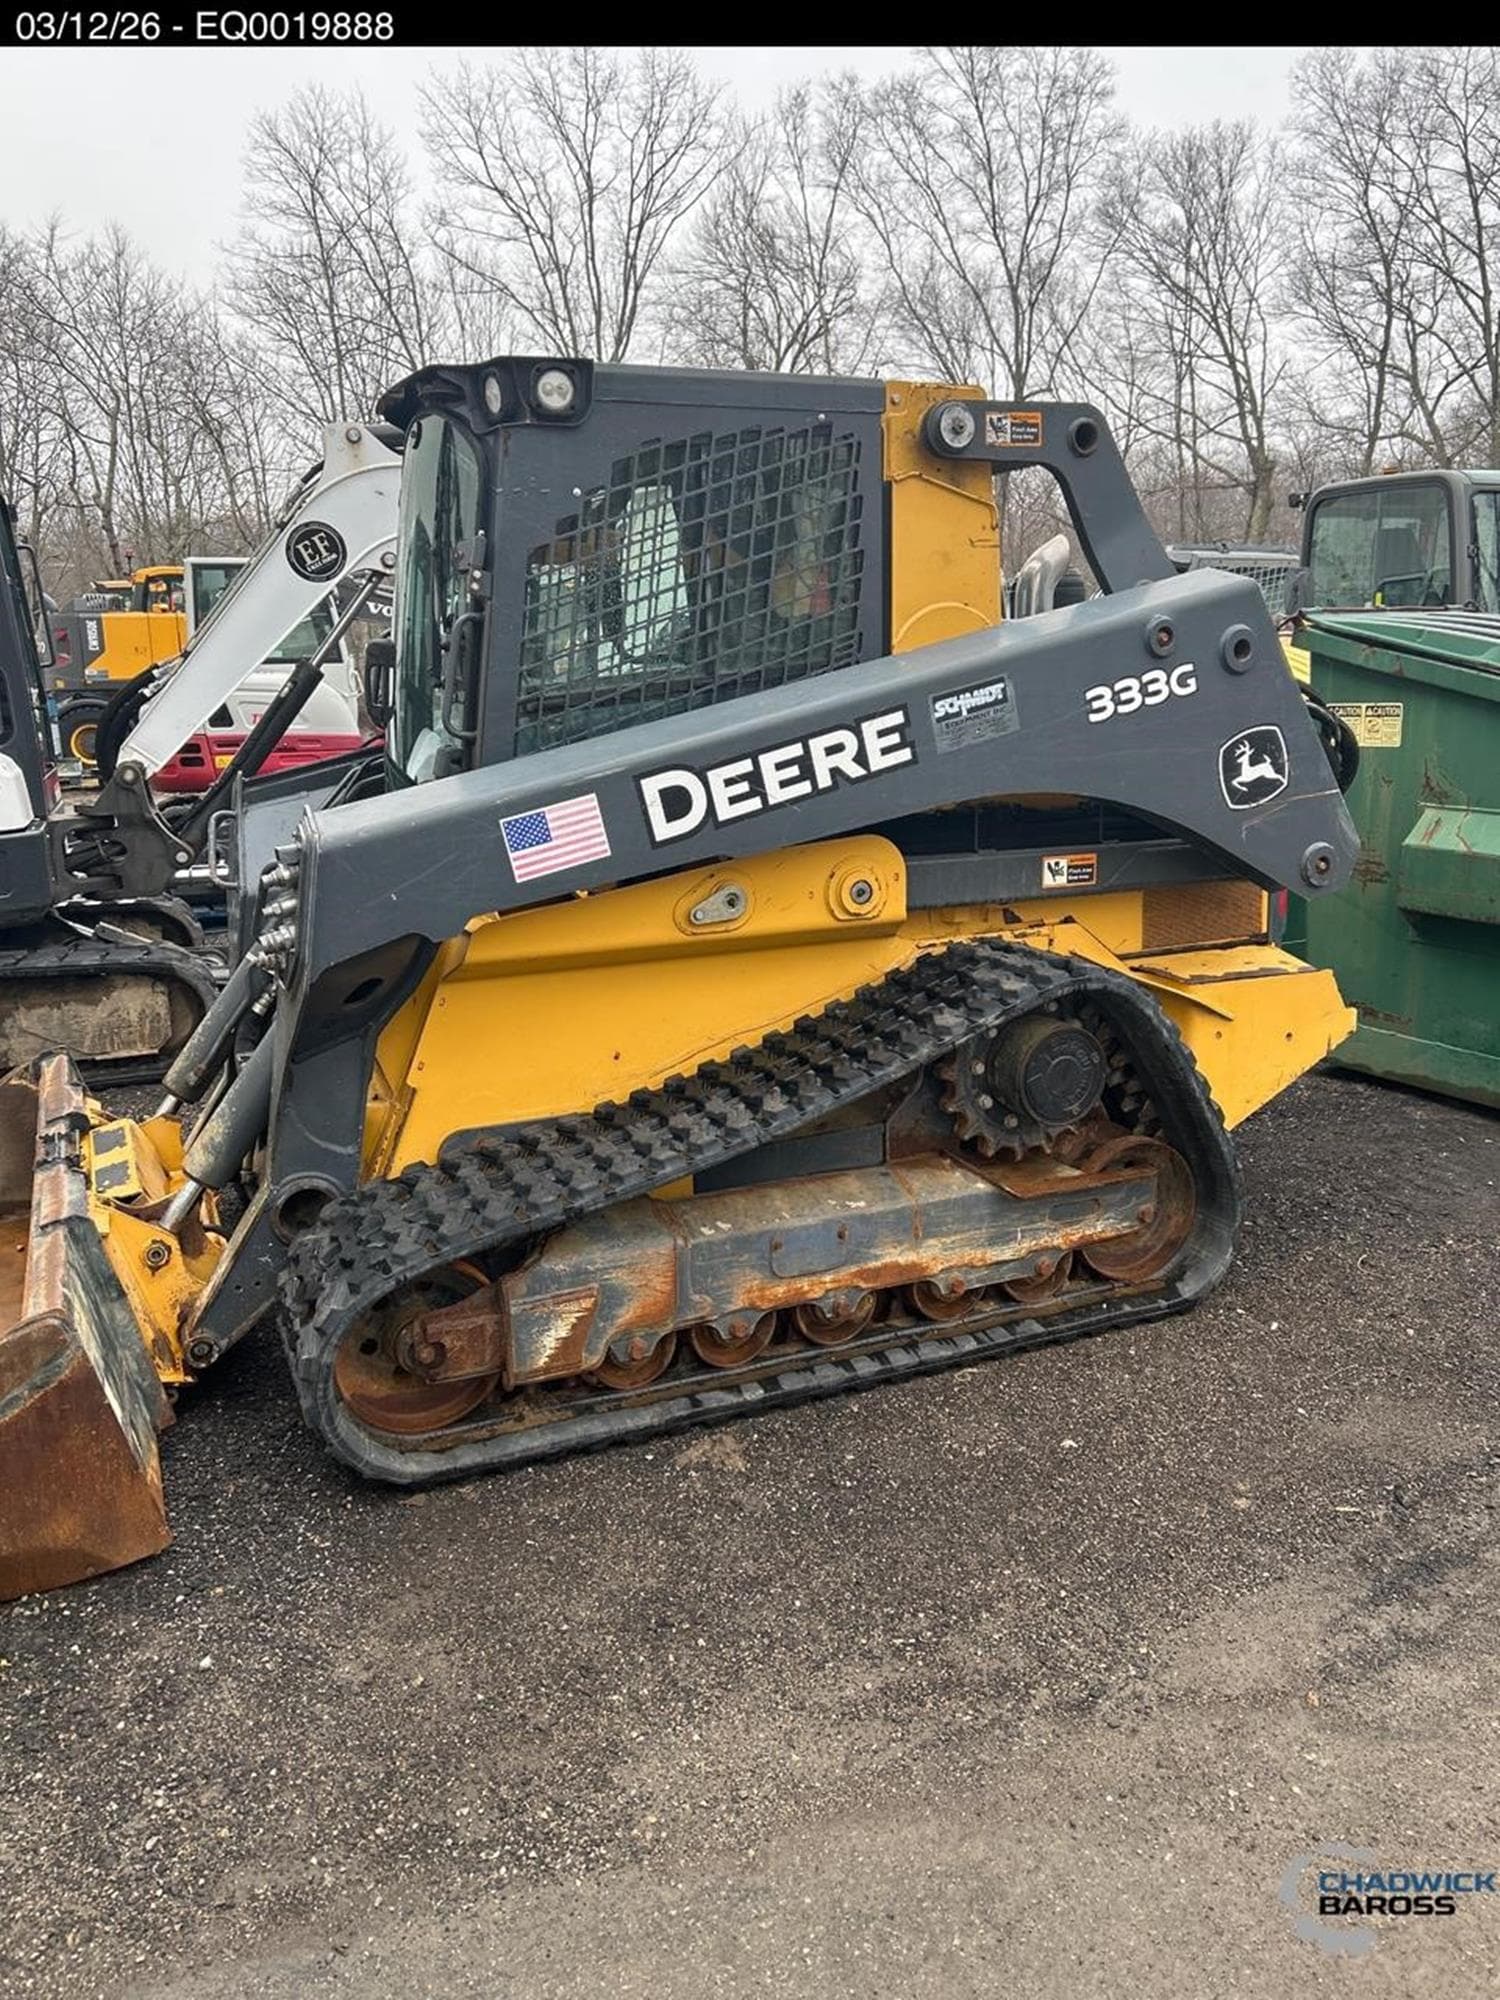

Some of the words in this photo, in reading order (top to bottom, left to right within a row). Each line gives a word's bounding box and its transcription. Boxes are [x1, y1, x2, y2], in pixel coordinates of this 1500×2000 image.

[295, 532, 330, 567] EF
[934, 683, 1004, 718] SCHMIDT
[1085, 663, 1197, 722] 333G
[640, 710, 912, 843] DEERE
